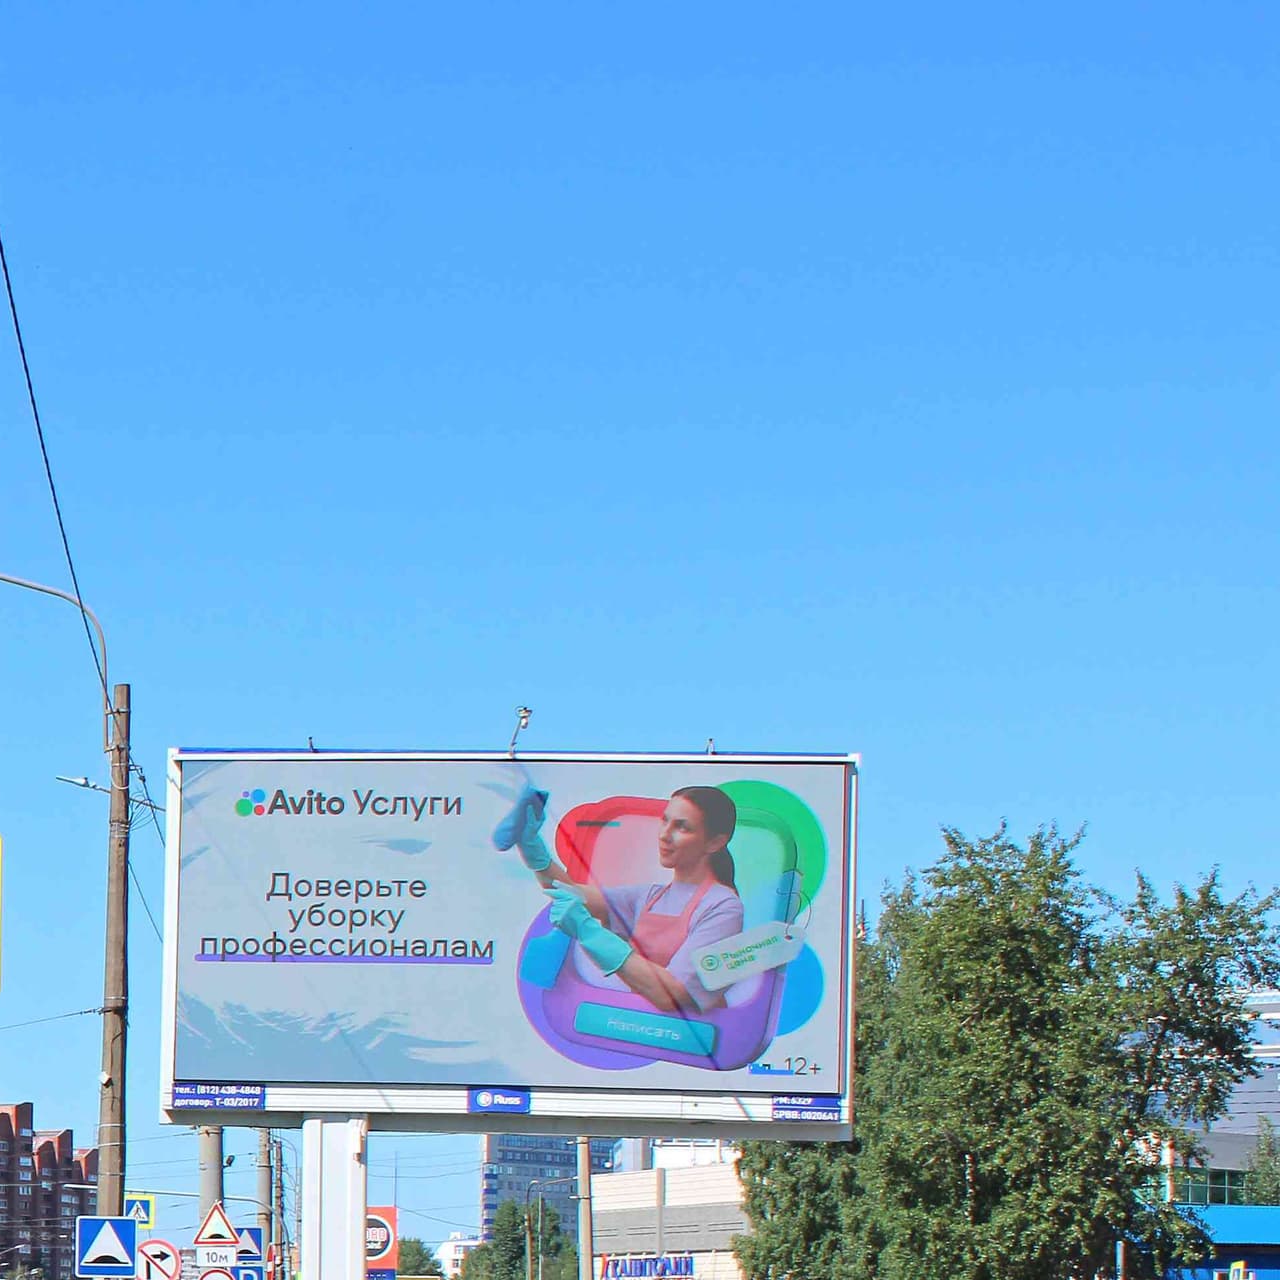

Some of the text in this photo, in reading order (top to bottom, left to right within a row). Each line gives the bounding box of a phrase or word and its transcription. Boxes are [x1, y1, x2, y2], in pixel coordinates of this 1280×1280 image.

[267, 789, 462, 821] Avito Услуги
[266, 872, 428, 904] Доверьте
[288, 903, 405, 934] уборку
[200, 931, 494, 962] профессионалам
[784, 1057, 822, 1076] 12+
[205, 1252, 228, 1263] 10м
